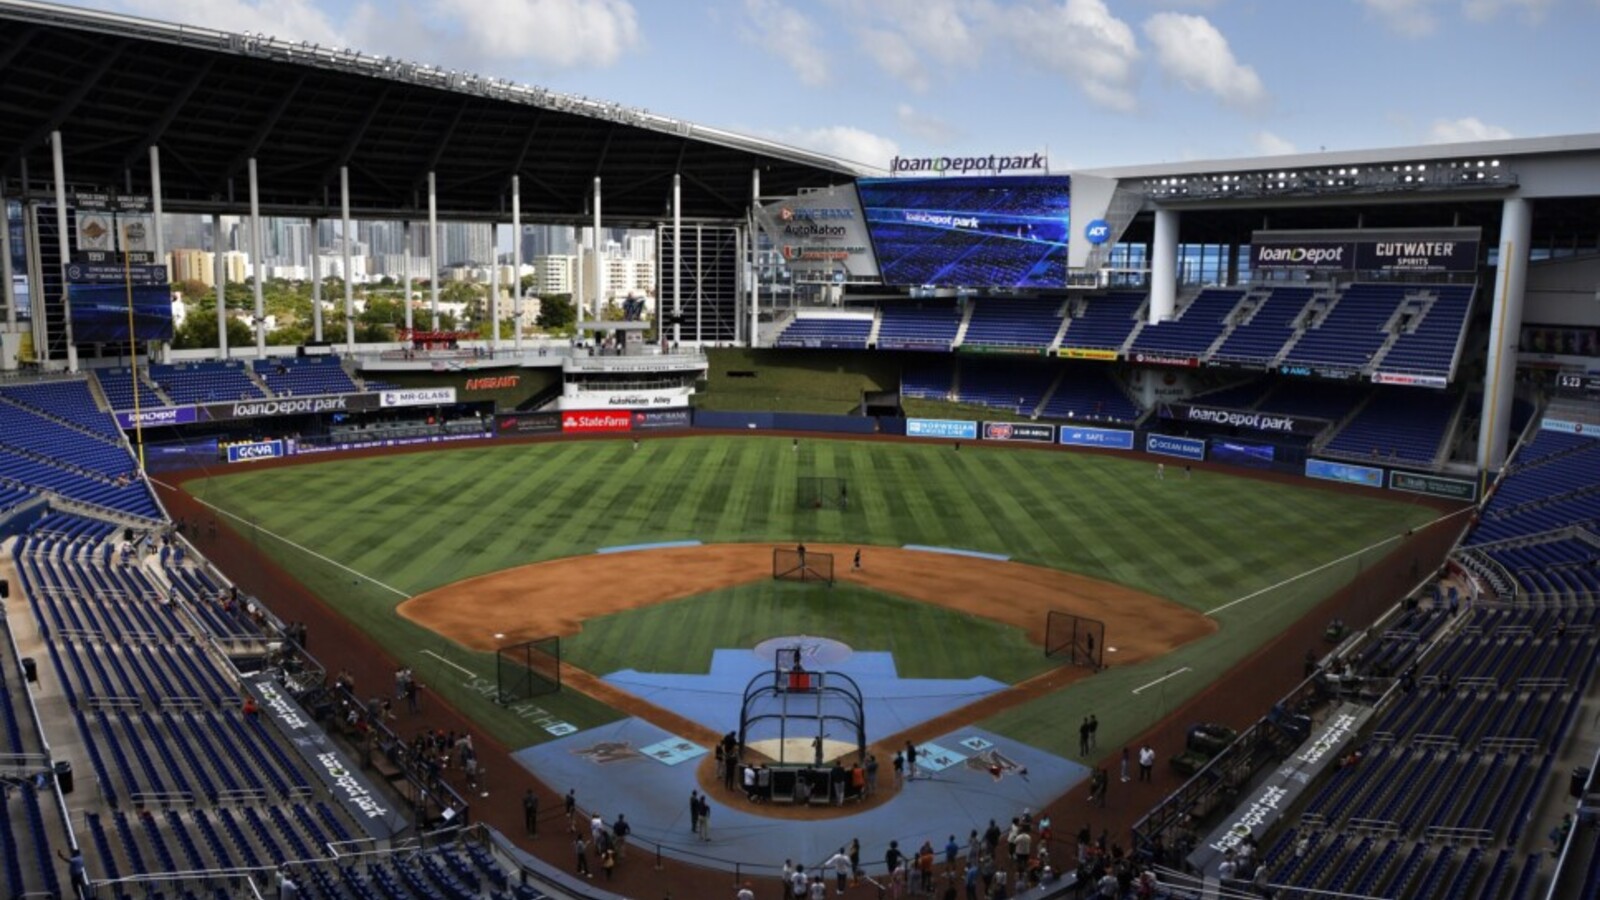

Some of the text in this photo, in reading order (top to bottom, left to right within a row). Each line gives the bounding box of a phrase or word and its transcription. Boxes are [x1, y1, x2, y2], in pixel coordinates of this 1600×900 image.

[893, 152, 1043, 174] loanDepot park
[785, 224, 846, 236] AutoNation
[905, 211, 980, 231] loanDepot park
[1088, 226, 1107, 236] ADT
[1258, 246, 1343, 264] loanDepot
[1375, 242, 1454, 257] CUTWATER
[465, 376, 520, 390] AMERANT
[233, 396, 347, 416] loanDepot park
[609, 396, 671, 405] AutoNation Alley
[921, 421, 974, 431] NORWEGIAN
[1189, 406, 1294, 431] loanDepot park
[1158, 442, 1200, 453] OCEAN BANK
[255, 681, 309, 730] loanDepot park
[1297, 714, 1356, 764] loanDepot park
[317, 752, 387, 819] loanDepot park
[1209, 785, 1288, 853] loanDepot park
